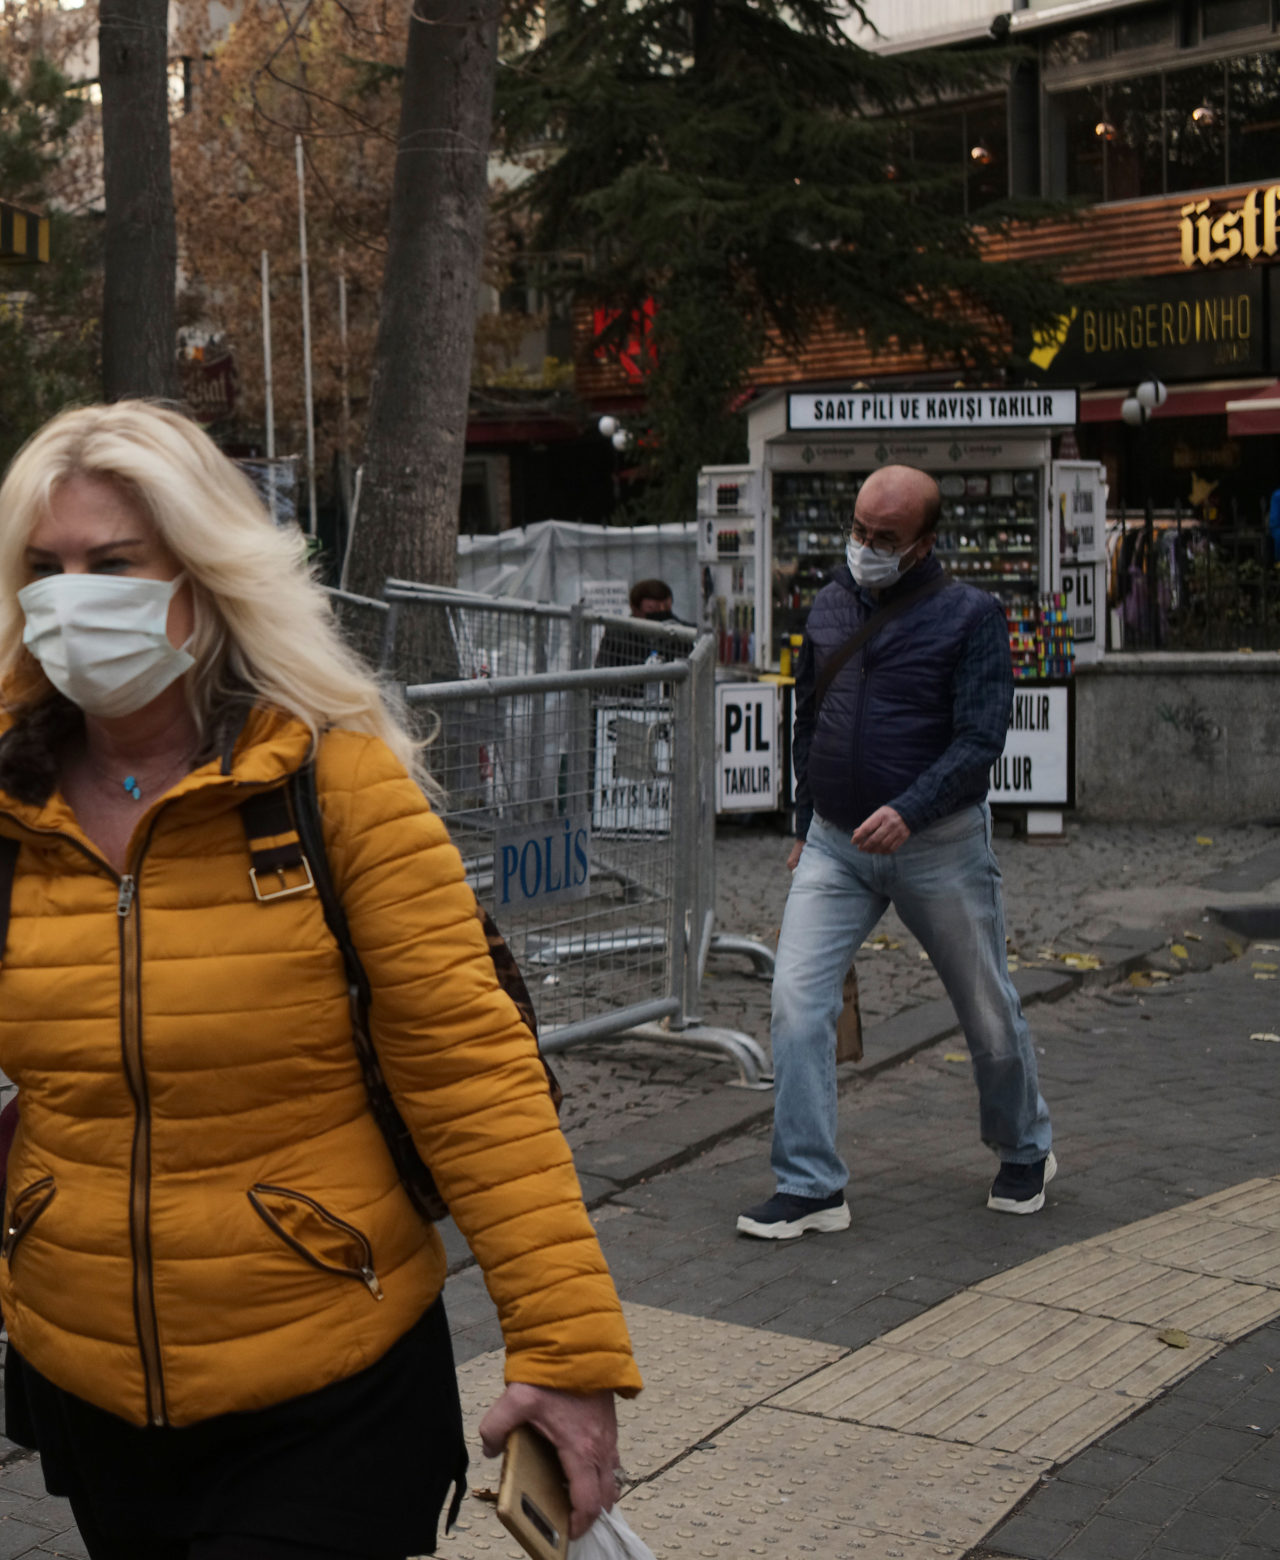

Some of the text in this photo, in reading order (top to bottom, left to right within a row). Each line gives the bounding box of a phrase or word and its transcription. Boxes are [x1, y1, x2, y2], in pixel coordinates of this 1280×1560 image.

[1082, 294, 1252, 354] BURGERDINHO
[814, 394, 1054, 422] SAAT PİLİ VE KAYIŞI TAKILIR
[724, 765, 771, 795] TAKILIR
[501, 817, 588, 904] POLİS
